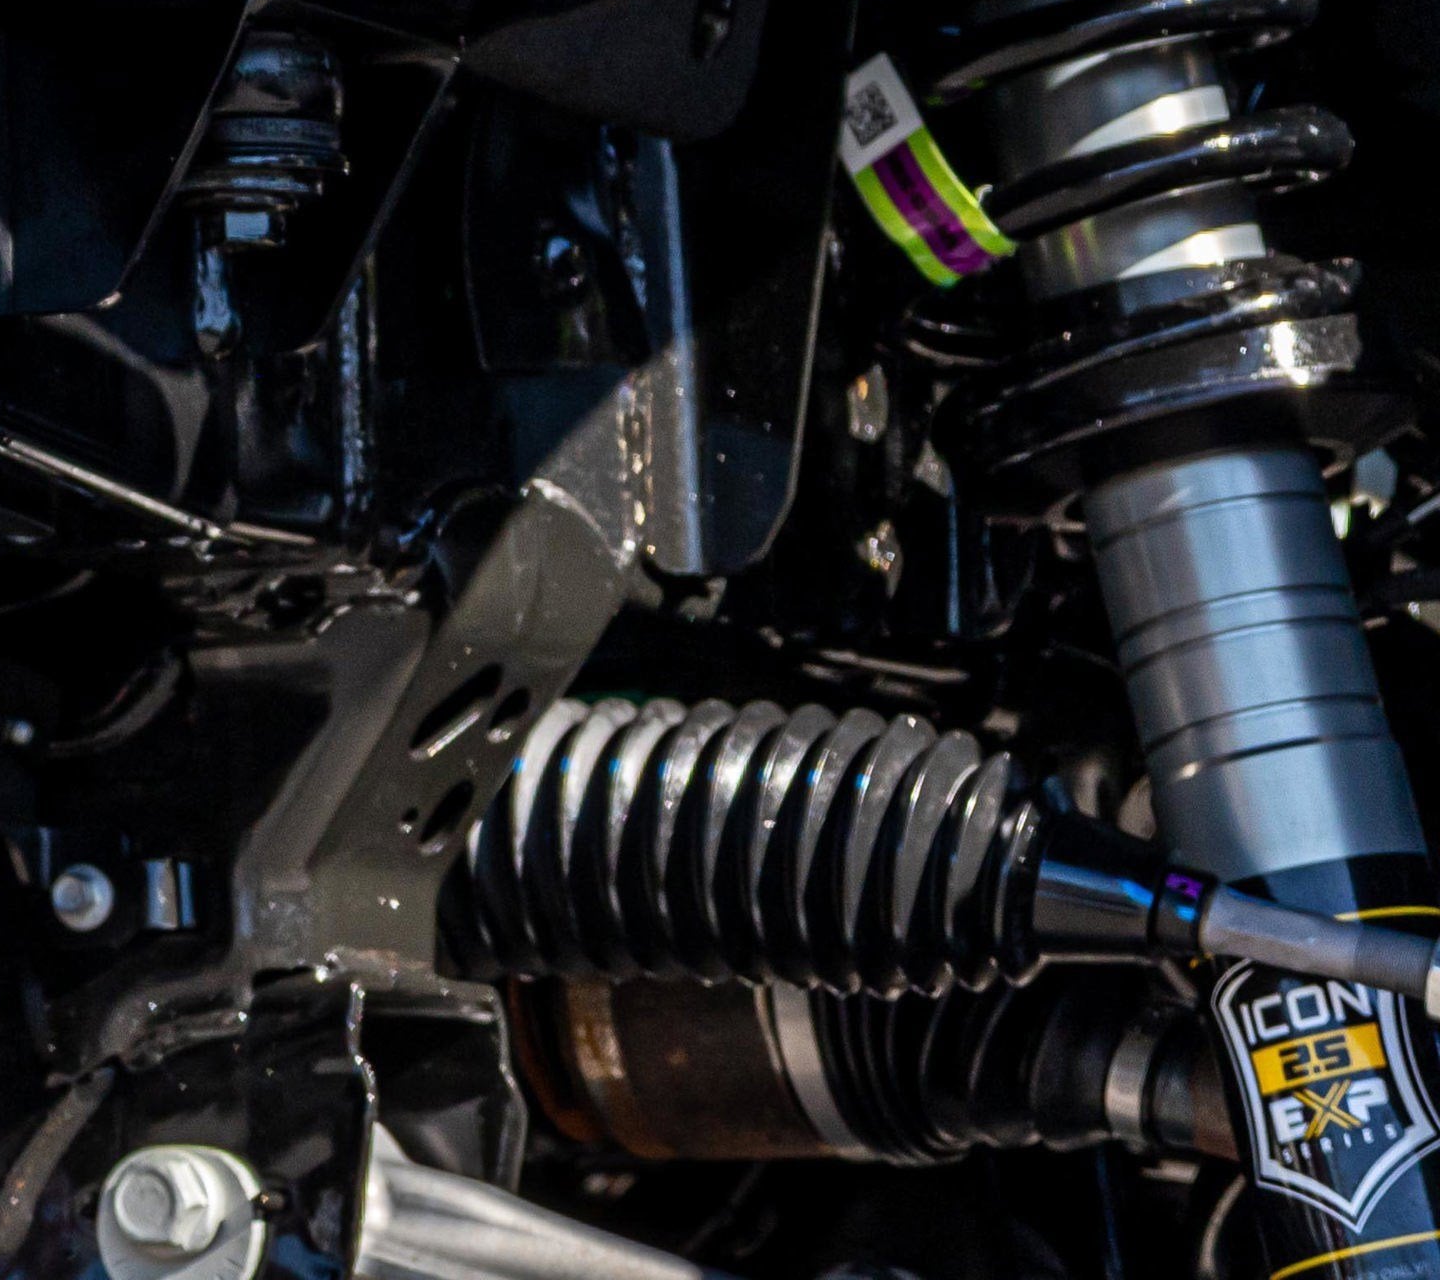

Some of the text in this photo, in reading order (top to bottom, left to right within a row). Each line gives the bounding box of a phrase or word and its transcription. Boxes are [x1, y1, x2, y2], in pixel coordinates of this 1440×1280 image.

[1240, 980, 1373, 1045] ICON
[1278, 1034, 1352, 1083] 2.5
[1268, 1076, 1390, 1146] EXP
